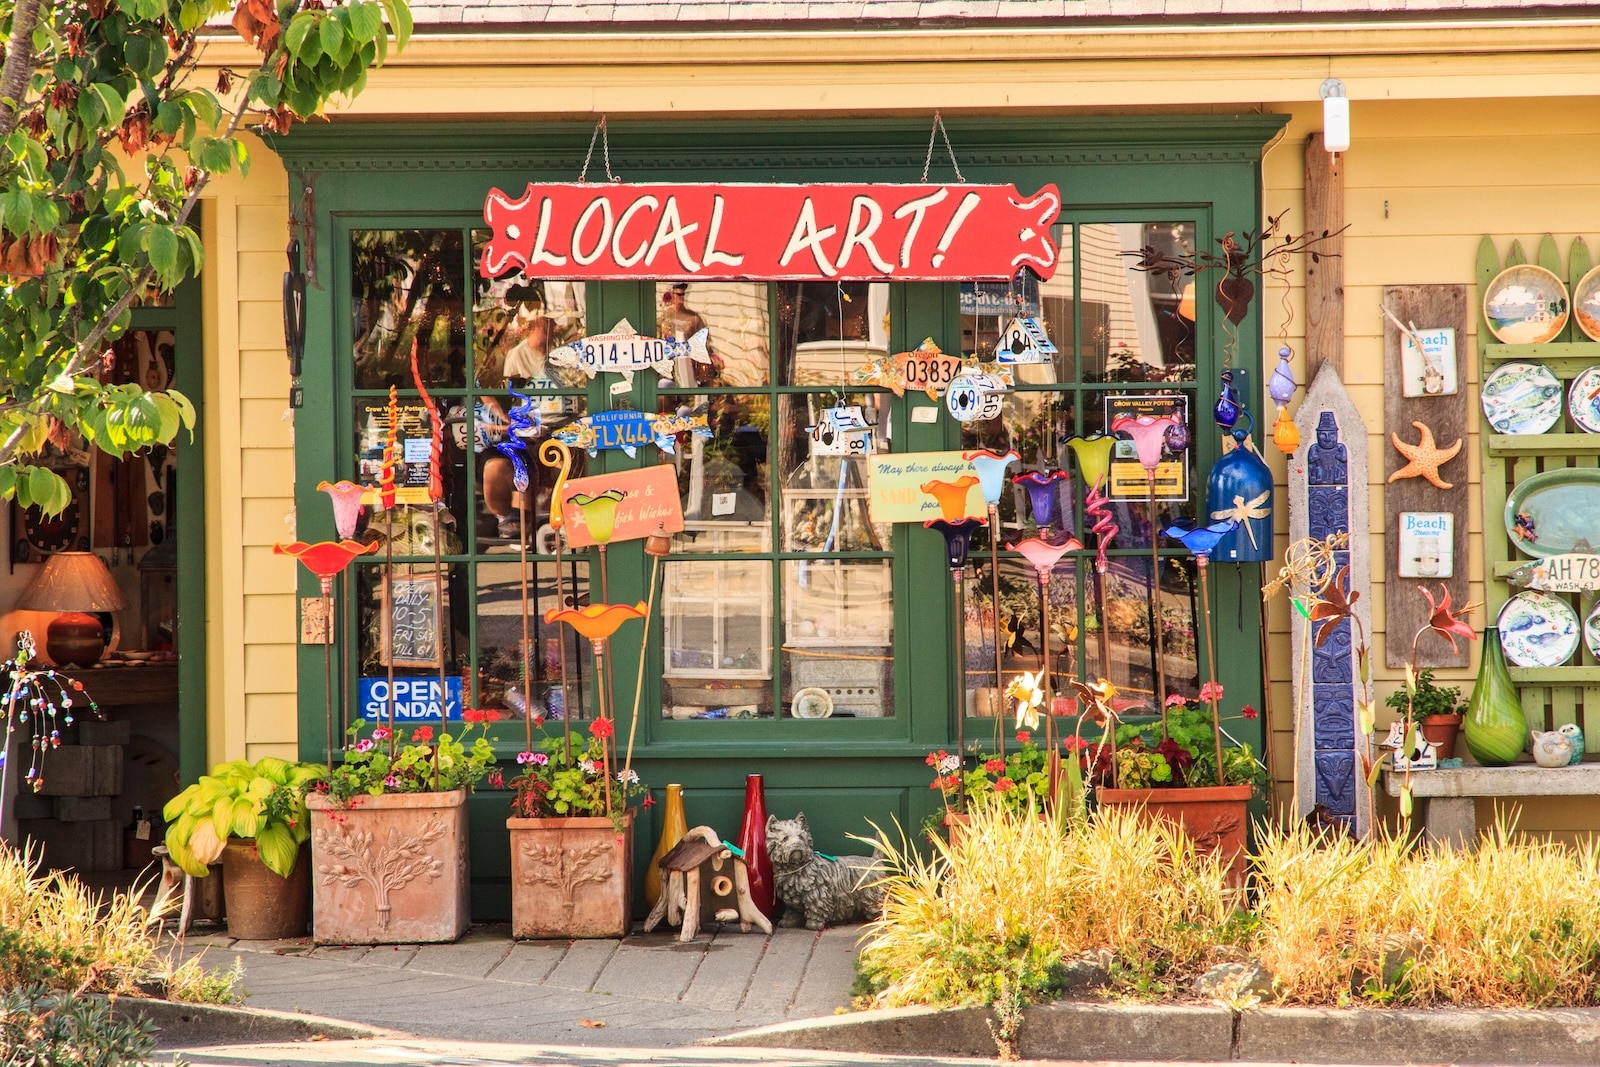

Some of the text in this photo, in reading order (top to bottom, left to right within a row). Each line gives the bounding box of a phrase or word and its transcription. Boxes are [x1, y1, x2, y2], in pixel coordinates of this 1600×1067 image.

[531, 187, 982, 277] LOCAL ART!
[588, 334, 635, 342] WASHINGTON
[585, 341, 664, 366] 814-LAD
[595, 412, 643, 423] CALIFORNIA
[877, 463, 902, 476] May
[905, 462, 929, 473] there
[931, 462, 964, 475] always
[644, 484, 655, 497] &
[880, 486, 918, 505] SAND
[639, 504, 673, 521] Wishes
[1406, 515, 1447, 531] Beach
[1548, 558, 1571, 580] AH
[393, 583, 427, 594] OPEN
[1555, 582, 1580, 590] WASH
[392, 606, 432, 624] 10-5
[416, 644, 431, 655] 6!
[370, 680, 449, 702] OPEN
[365, 701, 456, 718] SUNDAY
